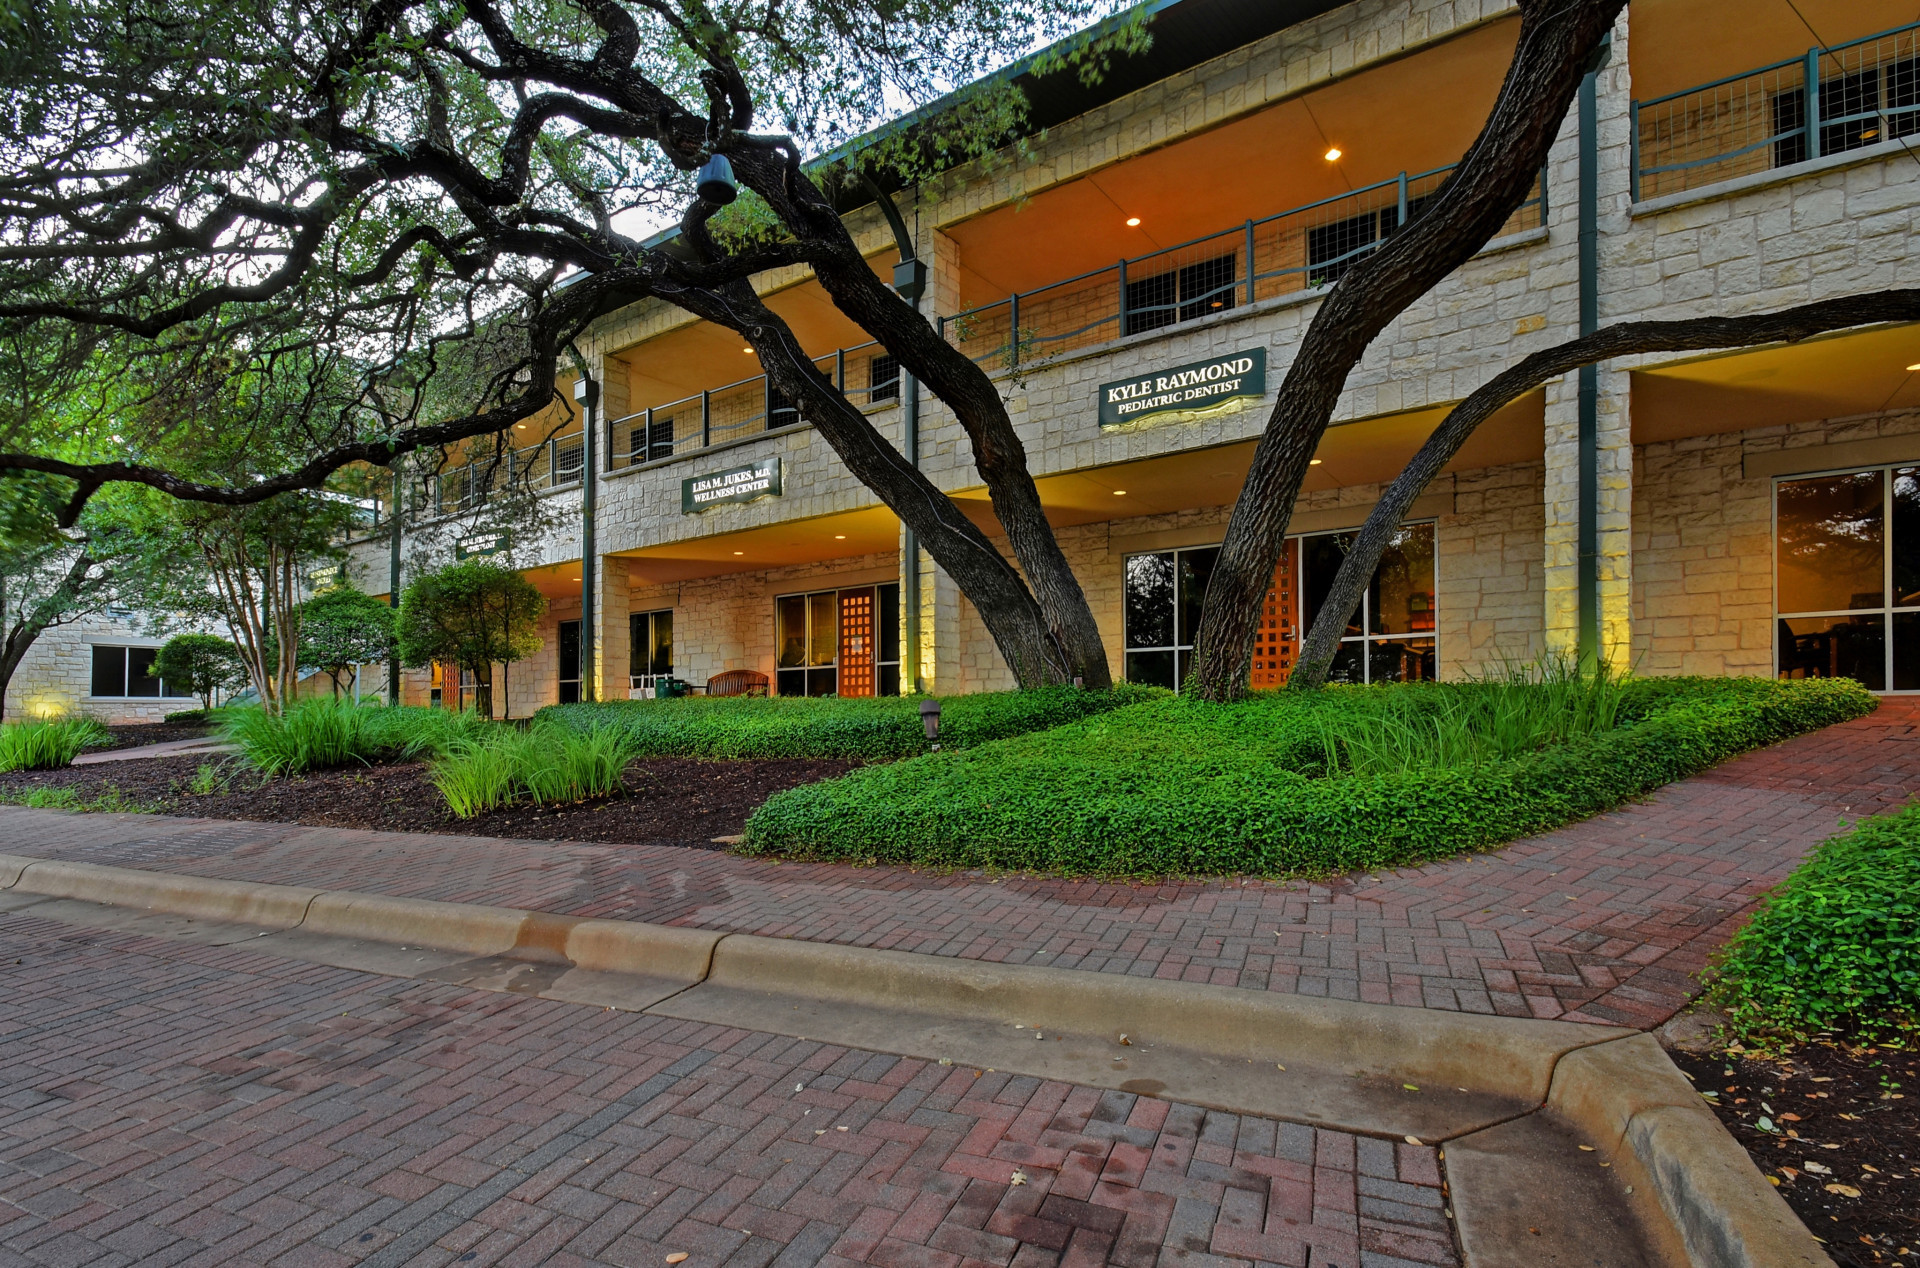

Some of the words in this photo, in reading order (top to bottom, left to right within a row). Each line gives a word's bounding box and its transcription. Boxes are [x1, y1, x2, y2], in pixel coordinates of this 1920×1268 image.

[1107, 380, 1153, 403] KYLE
[1156, 357, 1253, 393] RAYMOND
[1118, 391, 1183, 415] PEDIATRIC
[1185, 378, 1242, 401] DENTIST
[692, 481, 712, 493] LISA
[713, 477, 722, 488] M.
[724, 470, 754, 487] JUKES,
[755, 468, 771, 479] M.D.
[694, 486, 735, 503] WELLNESS
[736, 479, 769, 494] CENTER
